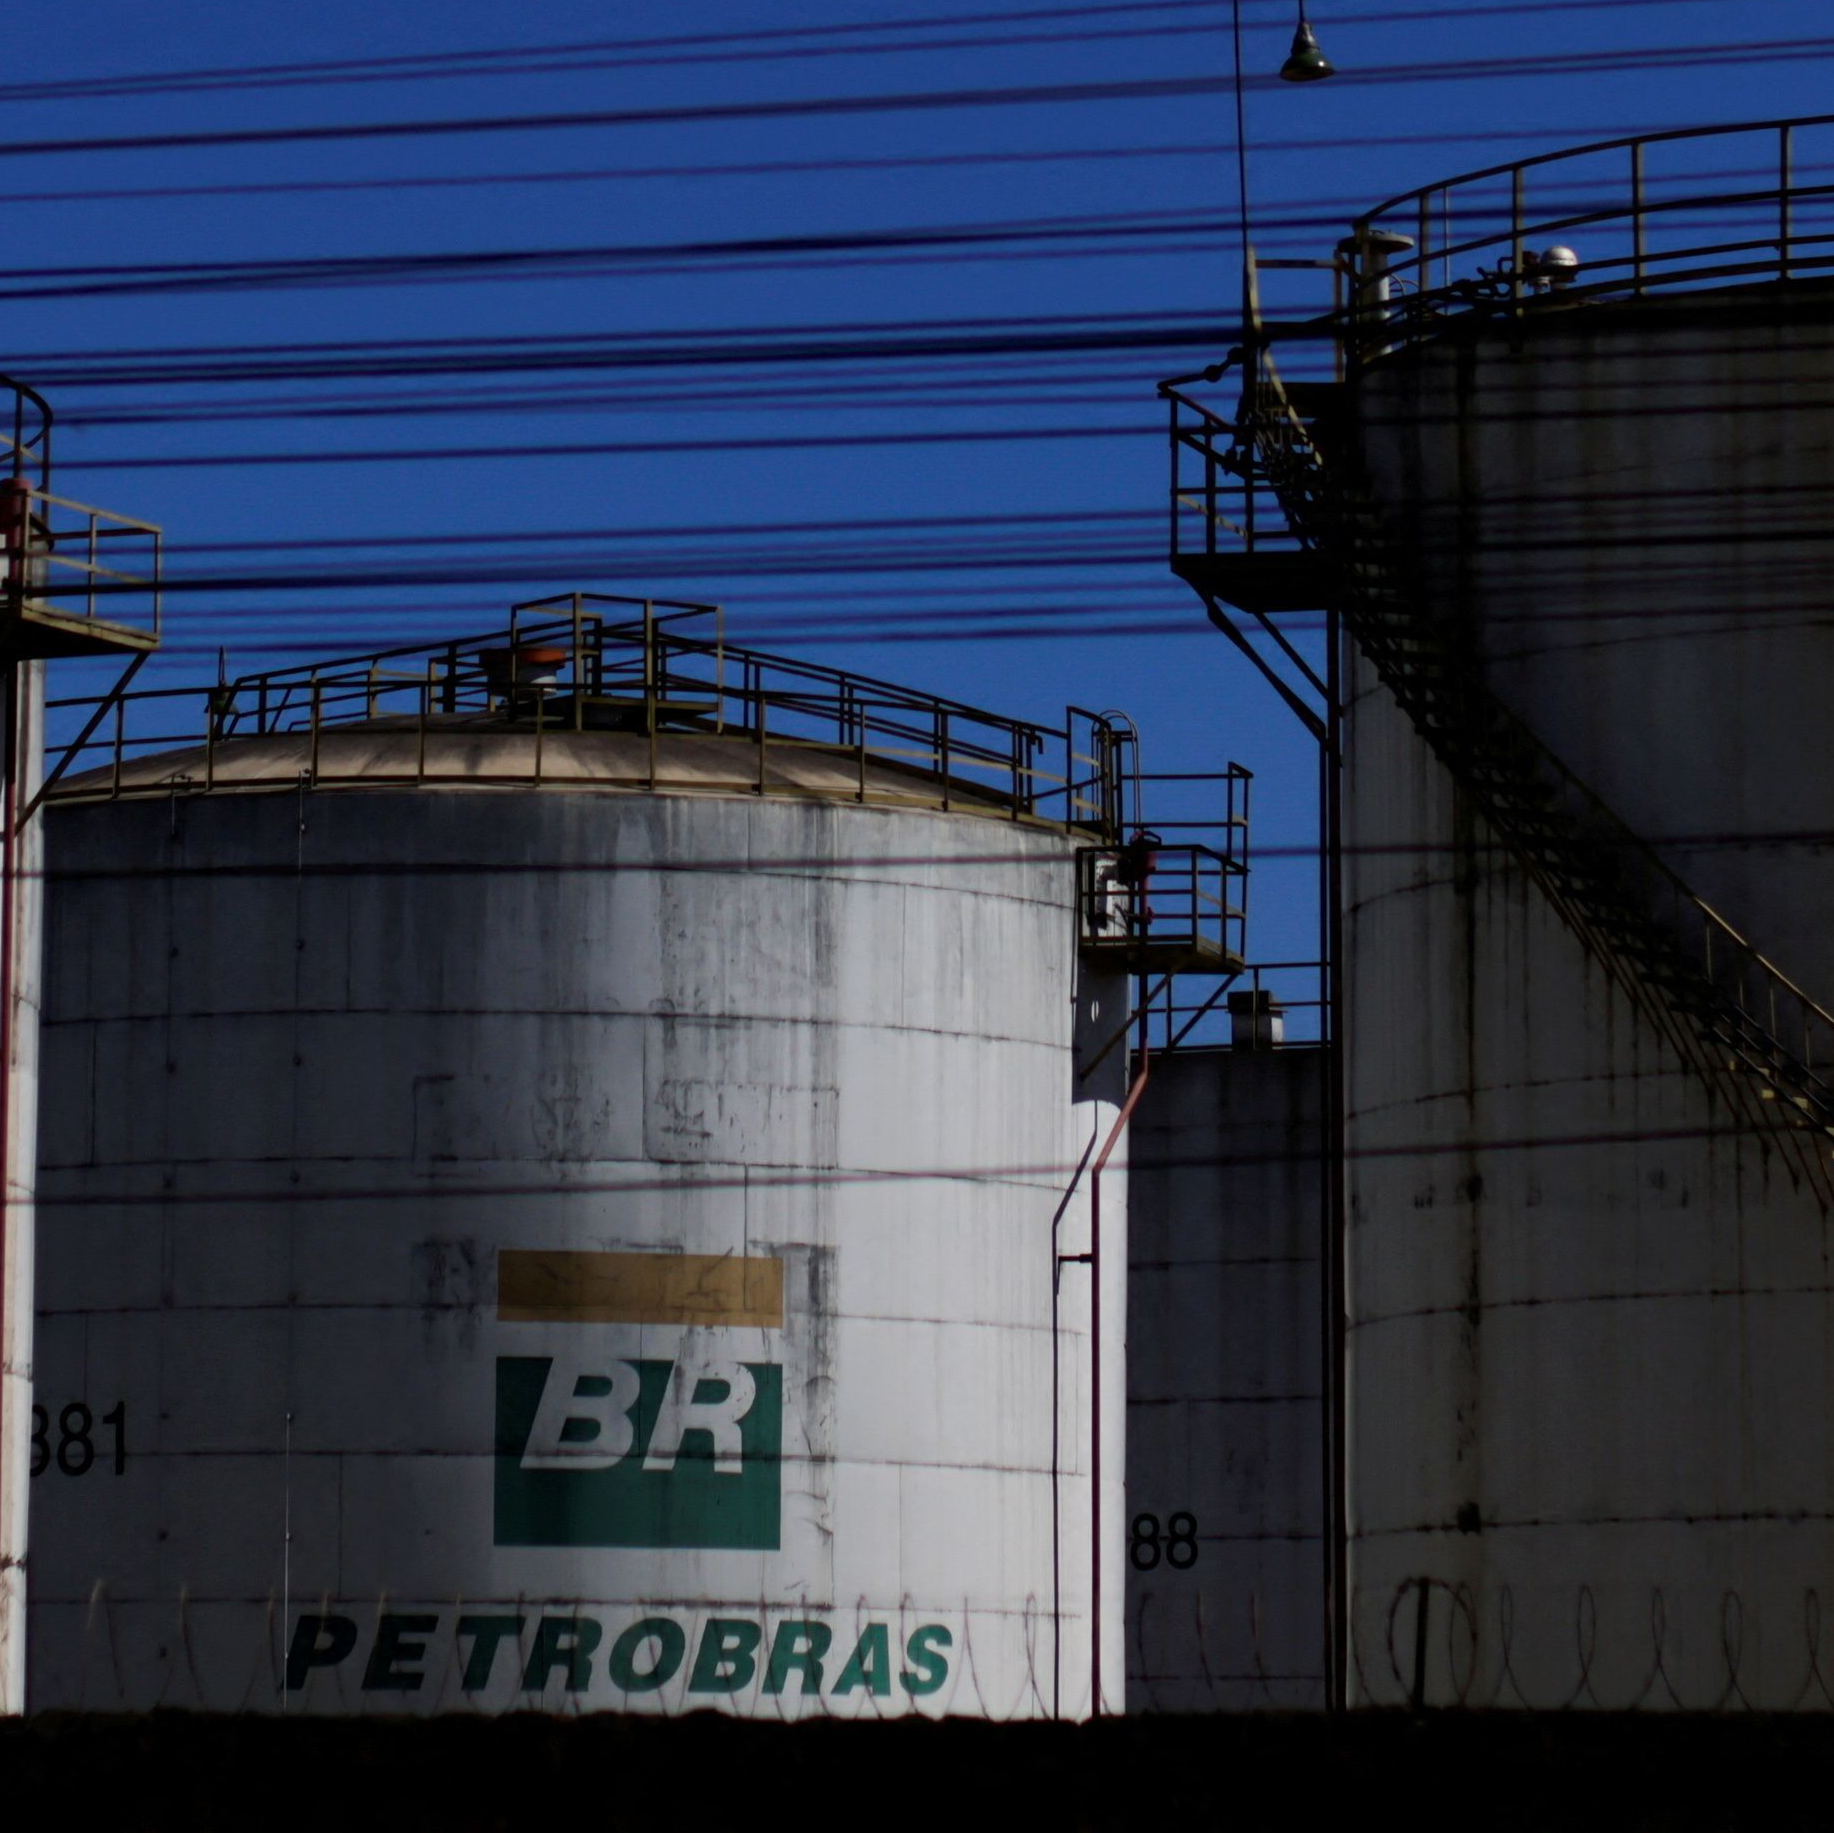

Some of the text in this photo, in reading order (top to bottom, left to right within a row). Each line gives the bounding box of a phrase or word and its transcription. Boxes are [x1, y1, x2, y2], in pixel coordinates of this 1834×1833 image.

[519, 1358, 757, 1474] BR
[1130, 1512, 1198, 1571] 88
[284, 1614, 953, 1698] PETROBRAS
